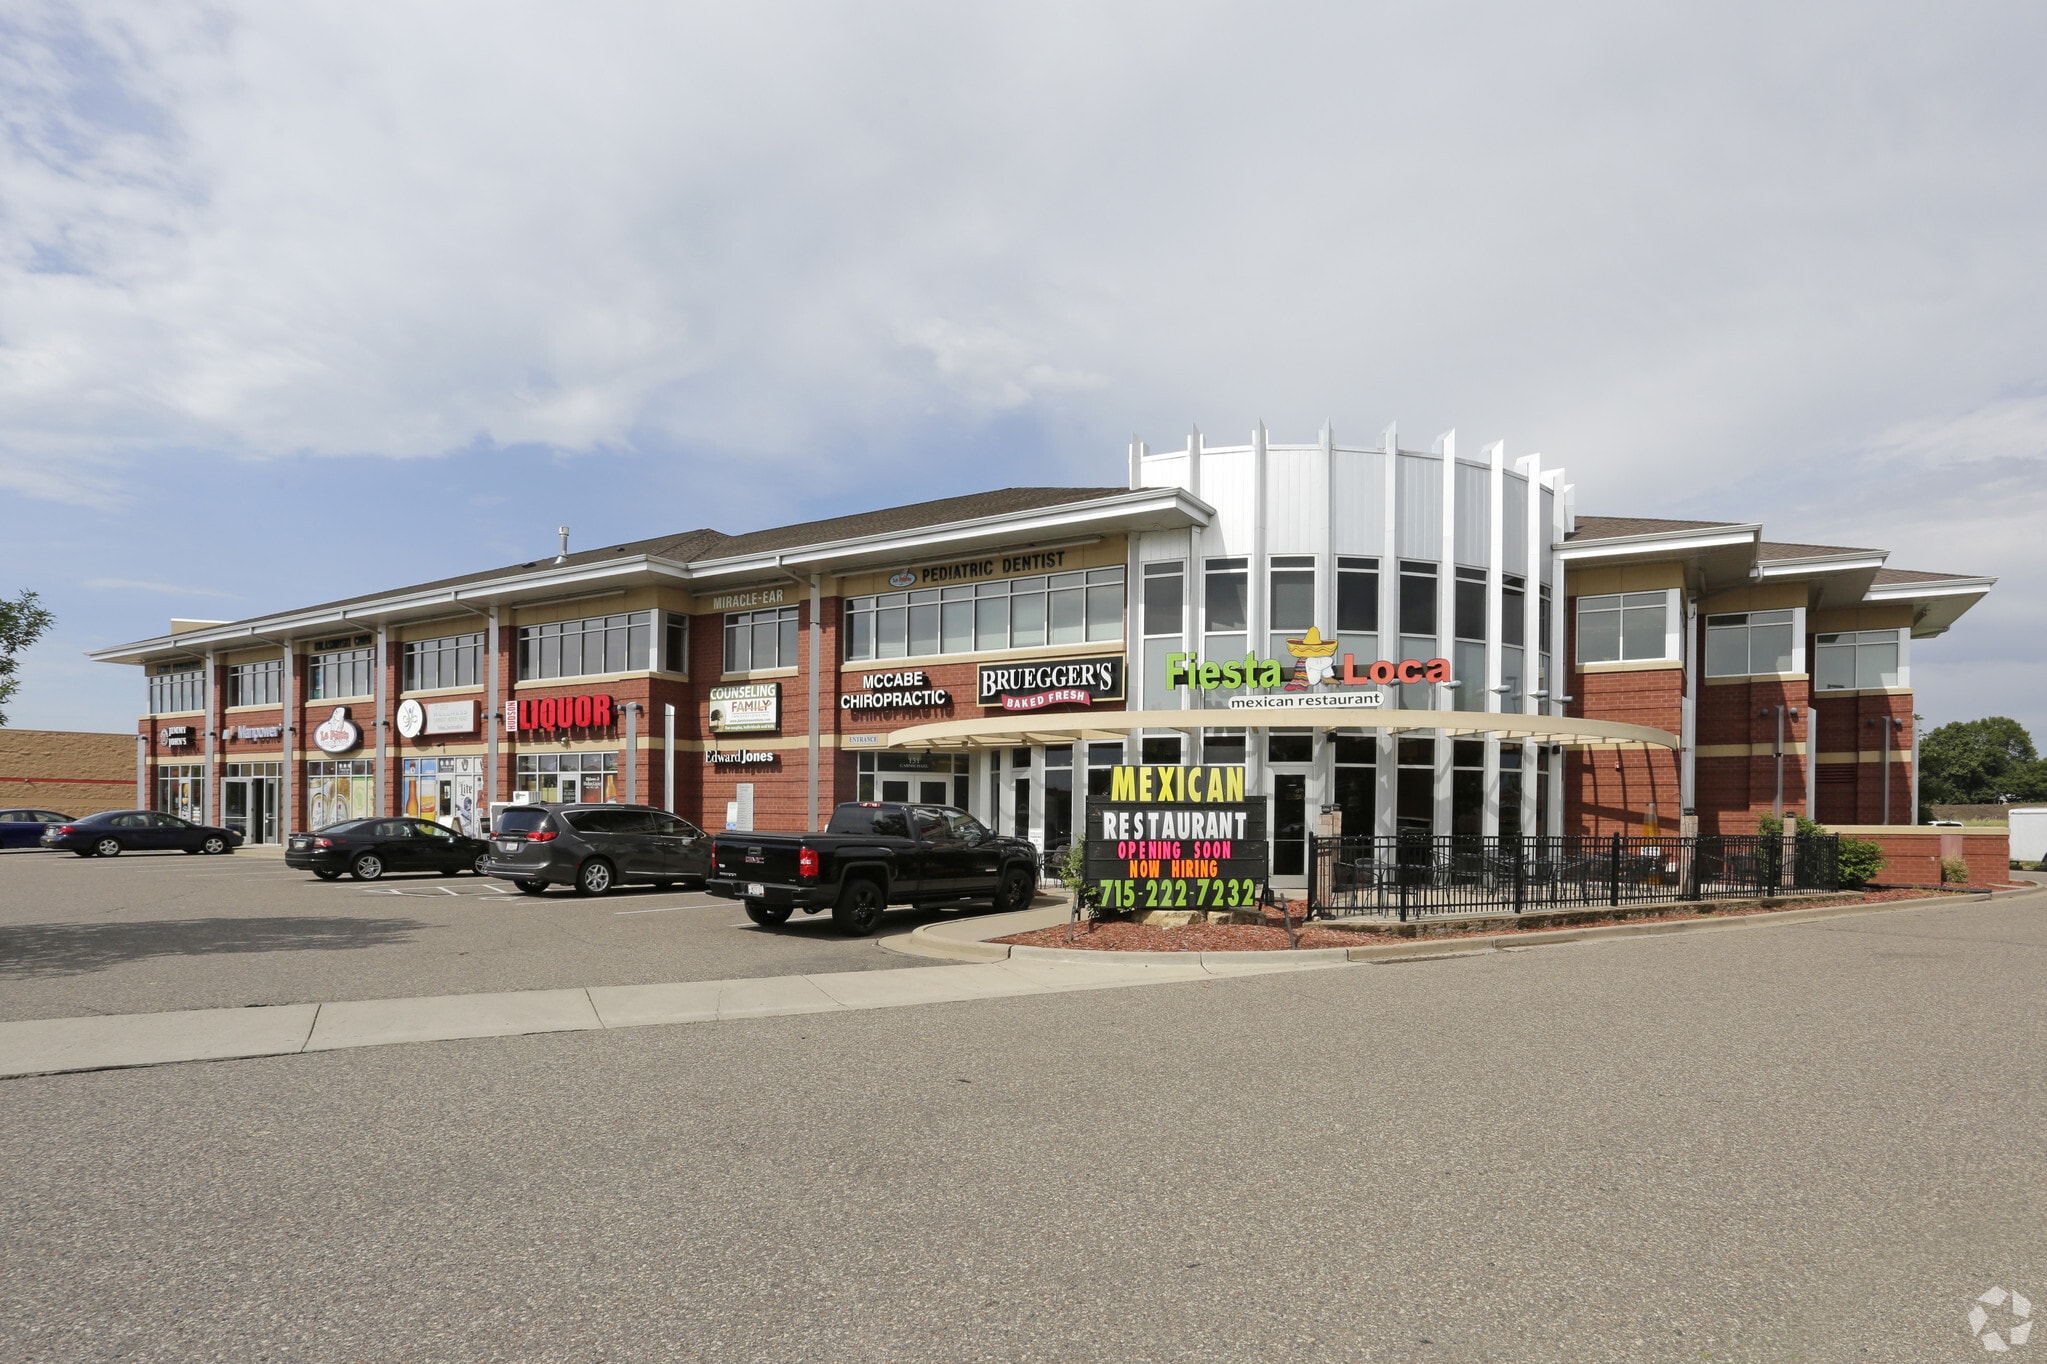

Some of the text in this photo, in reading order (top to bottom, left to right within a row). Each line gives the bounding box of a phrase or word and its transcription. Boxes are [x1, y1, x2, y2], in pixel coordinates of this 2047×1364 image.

[922, 551, 1065, 583] PEDIATRIC DENTIST
[713, 589, 783, 610] MIRACLE-EAR
[862, 671, 923, 689] MCCABE
[981, 662, 1112, 697] BRUEGGER'S
[1166, 650, 1451, 691] Fiesta Loca
[710, 684, 776, 700] COUNSELING
[841, 690, 946, 709] CHIROPRACTIC
[1006, 689, 1085, 709] BAKED FRESH
[1231, 692, 1380, 709] mexican restaurant
[507, 701, 516, 730] HUDSON
[519, 694, 611, 732] LIQUOR
[731, 699, 770, 713] FAMILY
[168, 726, 187, 736] JIMMY
[238, 725, 278, 741] Manpower
[168, 737, 187, 748] JOHN'S
[705, 749, 774, 764] Edward Jones
[460, 783, 472, 797] Lite
[1111, 766, 1244, 802] MEXICAN
[1103, 811, 1247, 840] RESTAURANT
[1118, 841, 1231, 859] OPENING SOON
[1129, 859, 1218, 878] NOW HIRING
[1100, 878, 1255, 908] 715-222-7232
